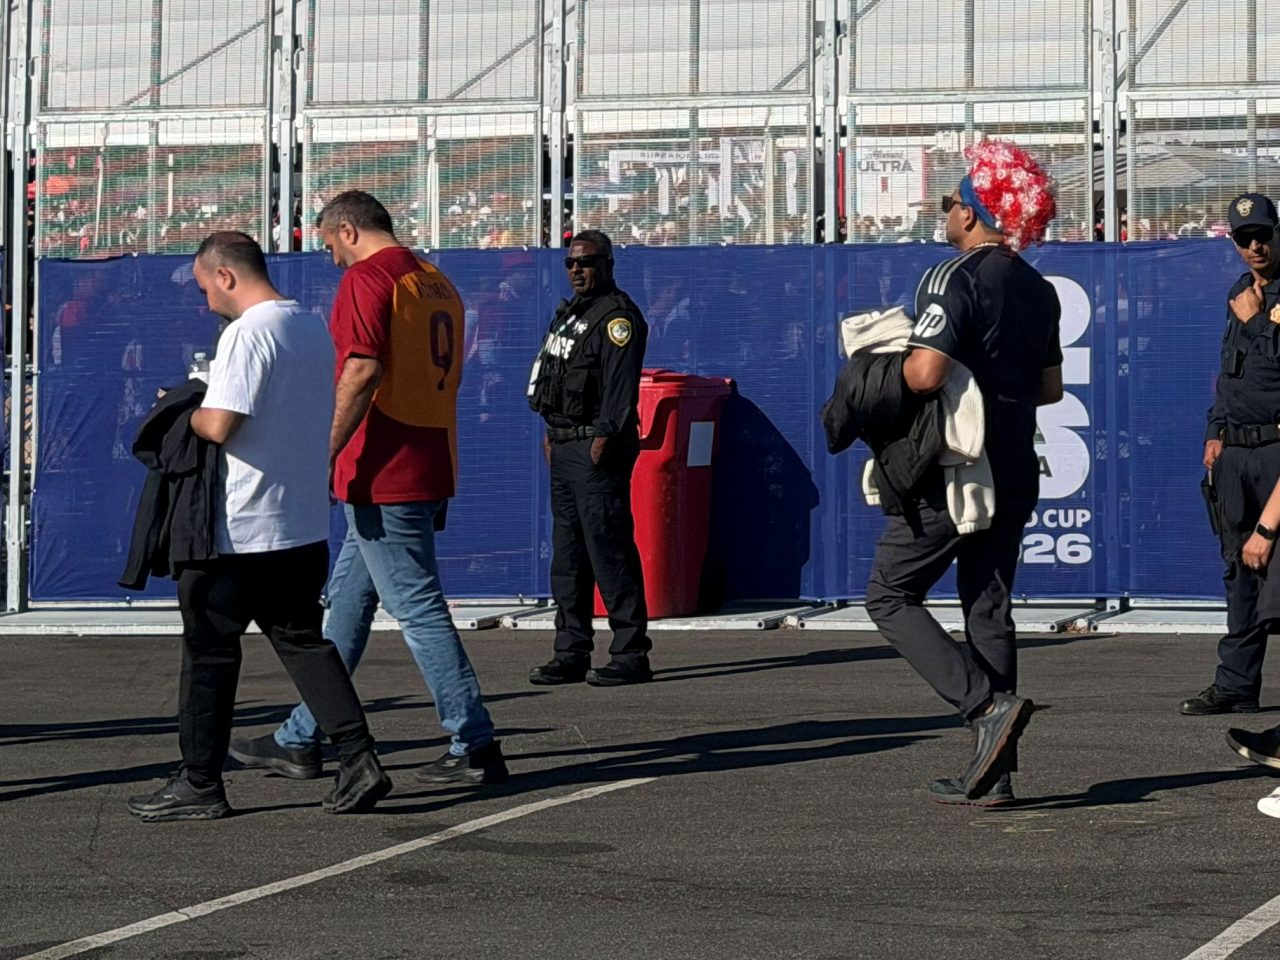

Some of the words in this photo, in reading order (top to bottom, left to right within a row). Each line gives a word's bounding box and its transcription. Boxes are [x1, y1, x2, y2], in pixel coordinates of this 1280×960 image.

[858, 160, 914, 172] ULTRA
[429, 310, 454, 391] 9
[1042, 509, 1092, 528] CUP
[1020, 533, 1092, 564] 26
